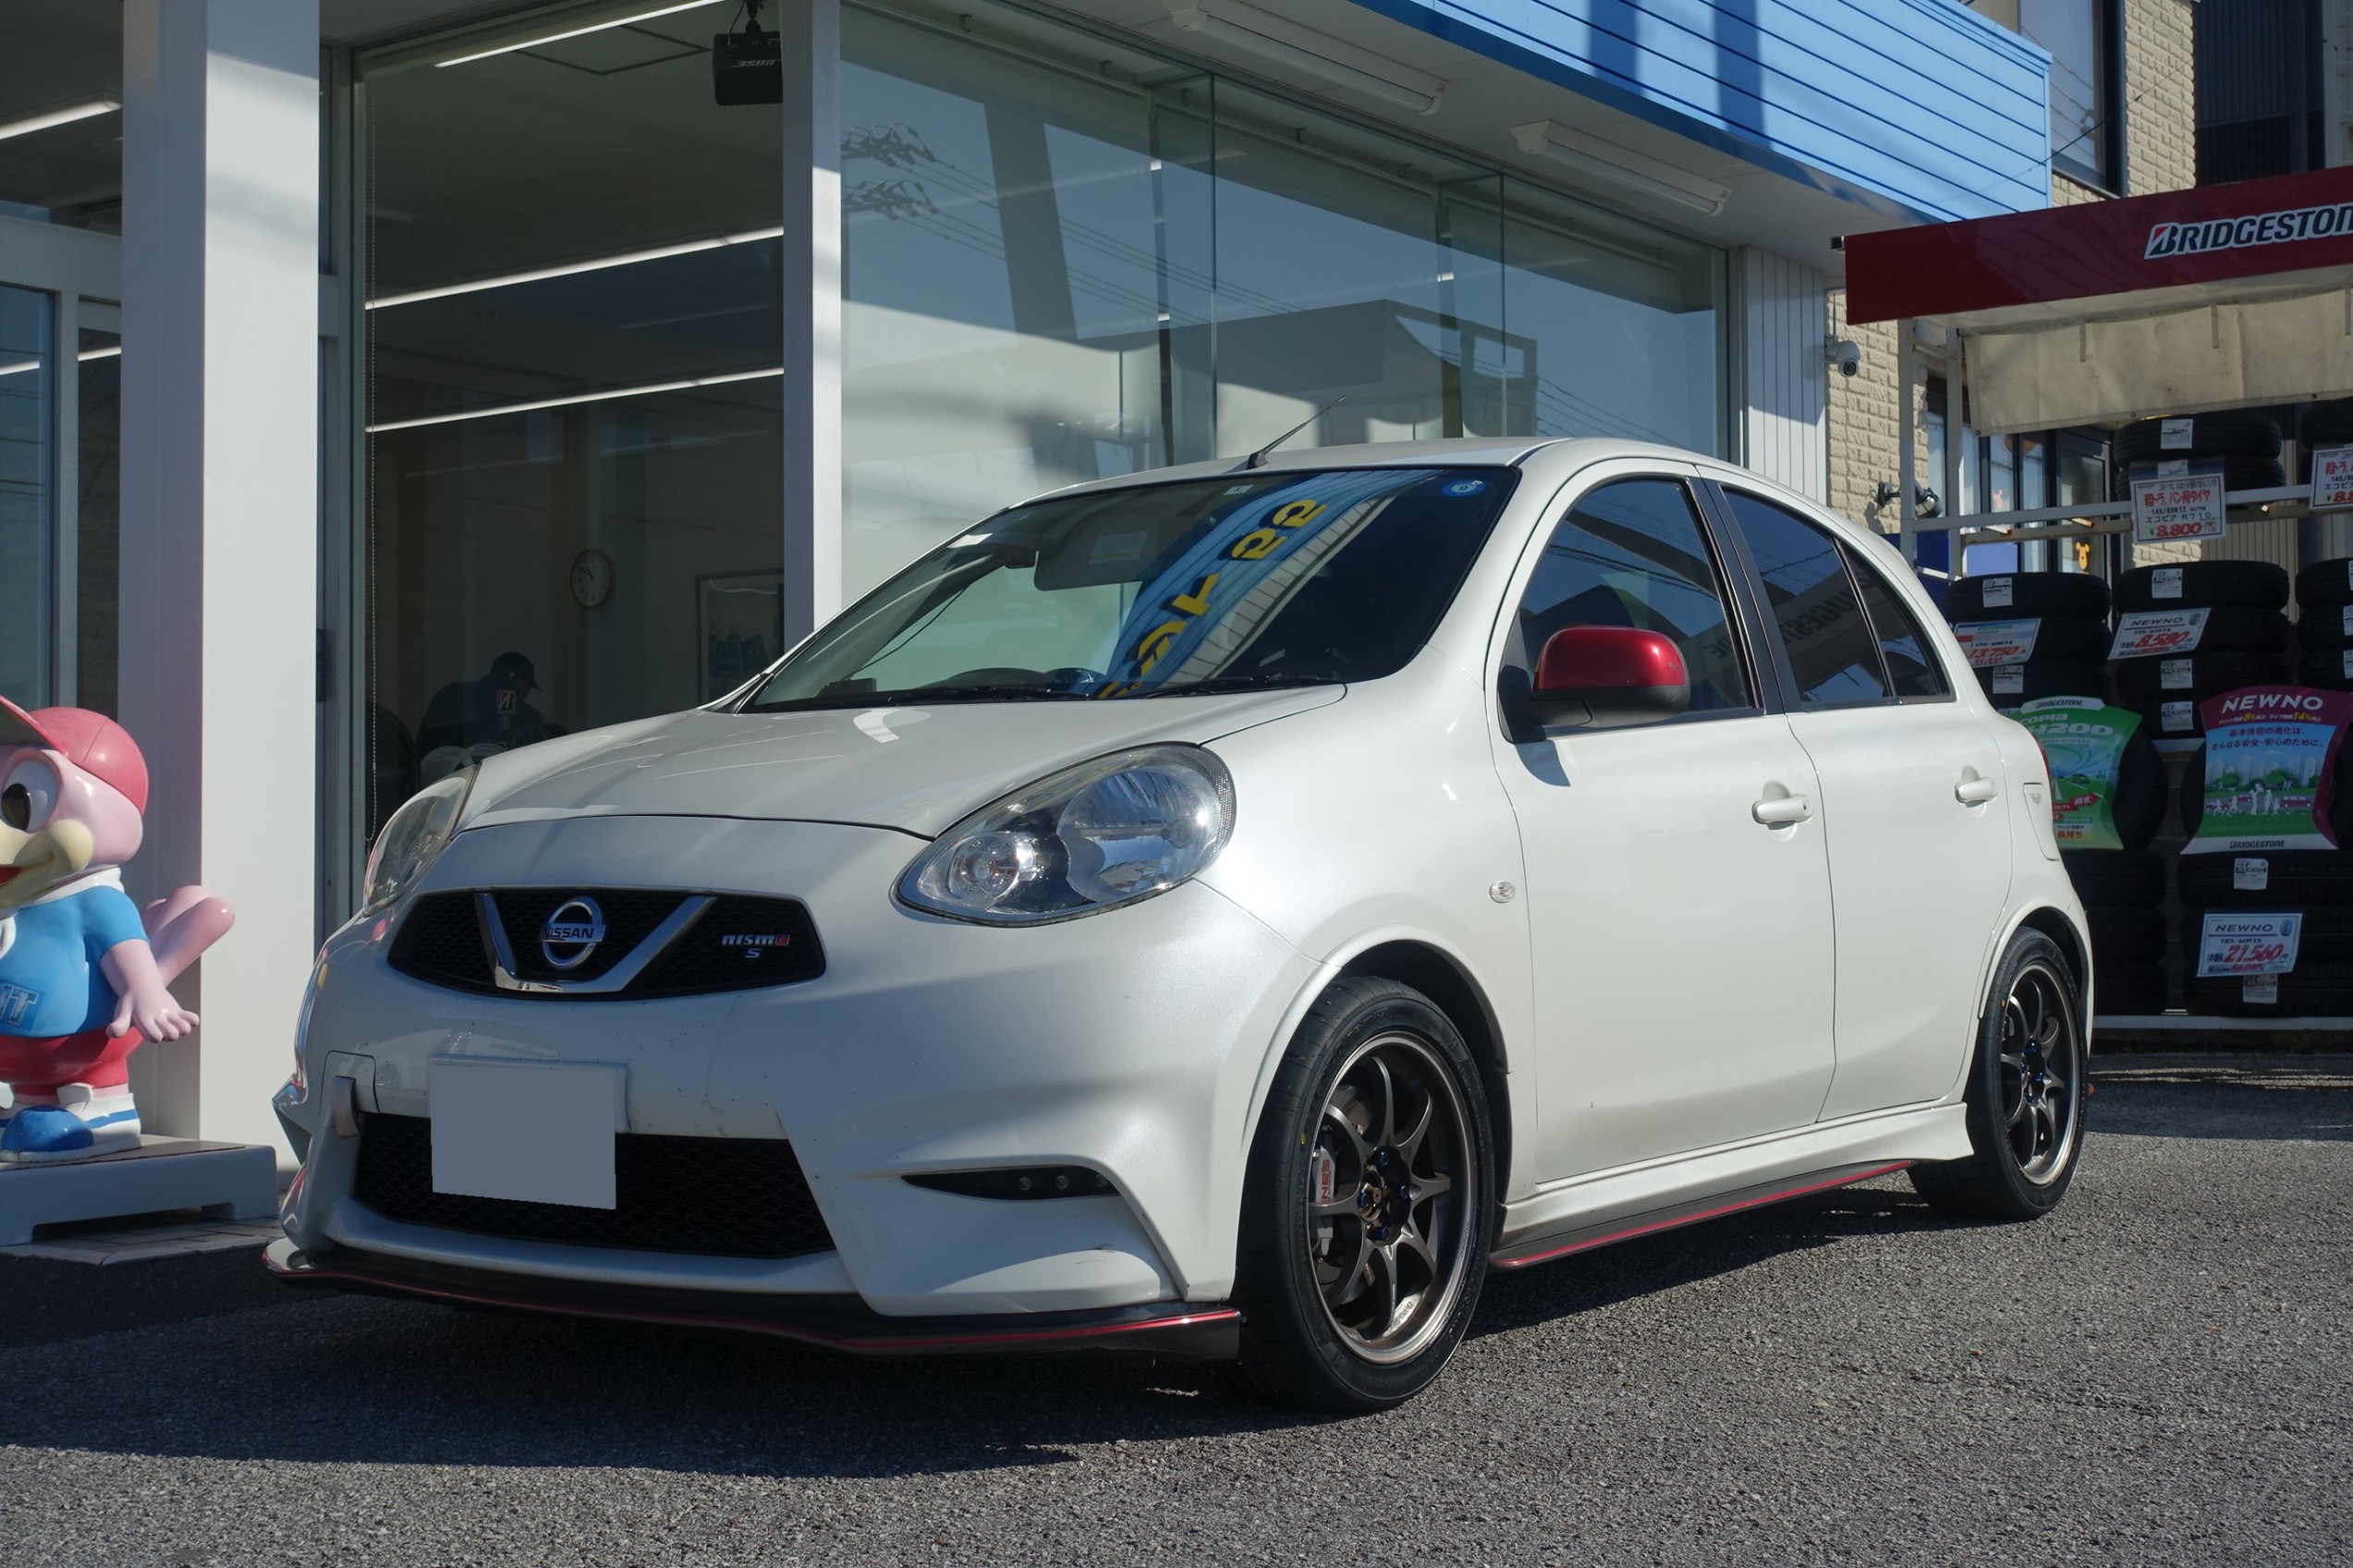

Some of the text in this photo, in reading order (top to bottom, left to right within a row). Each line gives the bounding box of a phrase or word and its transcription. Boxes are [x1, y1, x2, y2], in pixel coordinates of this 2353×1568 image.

[2131, 617, 2183, 626] NEWNO
[2036, 699, 2084, 709] BRIDGESTONE
[2221, 694, 2323, 714] NEWNO
[2020, 713, 2068, 725] COPIA
[2029, 723, 2114, 736] H200
[2229, 840, 2286, 849] BRIDGESTONE
[543, 927, 594, 939] NISSAN
[2215, 924, 2274, 932] NEWNO
[745, 948, 762, 958] S
